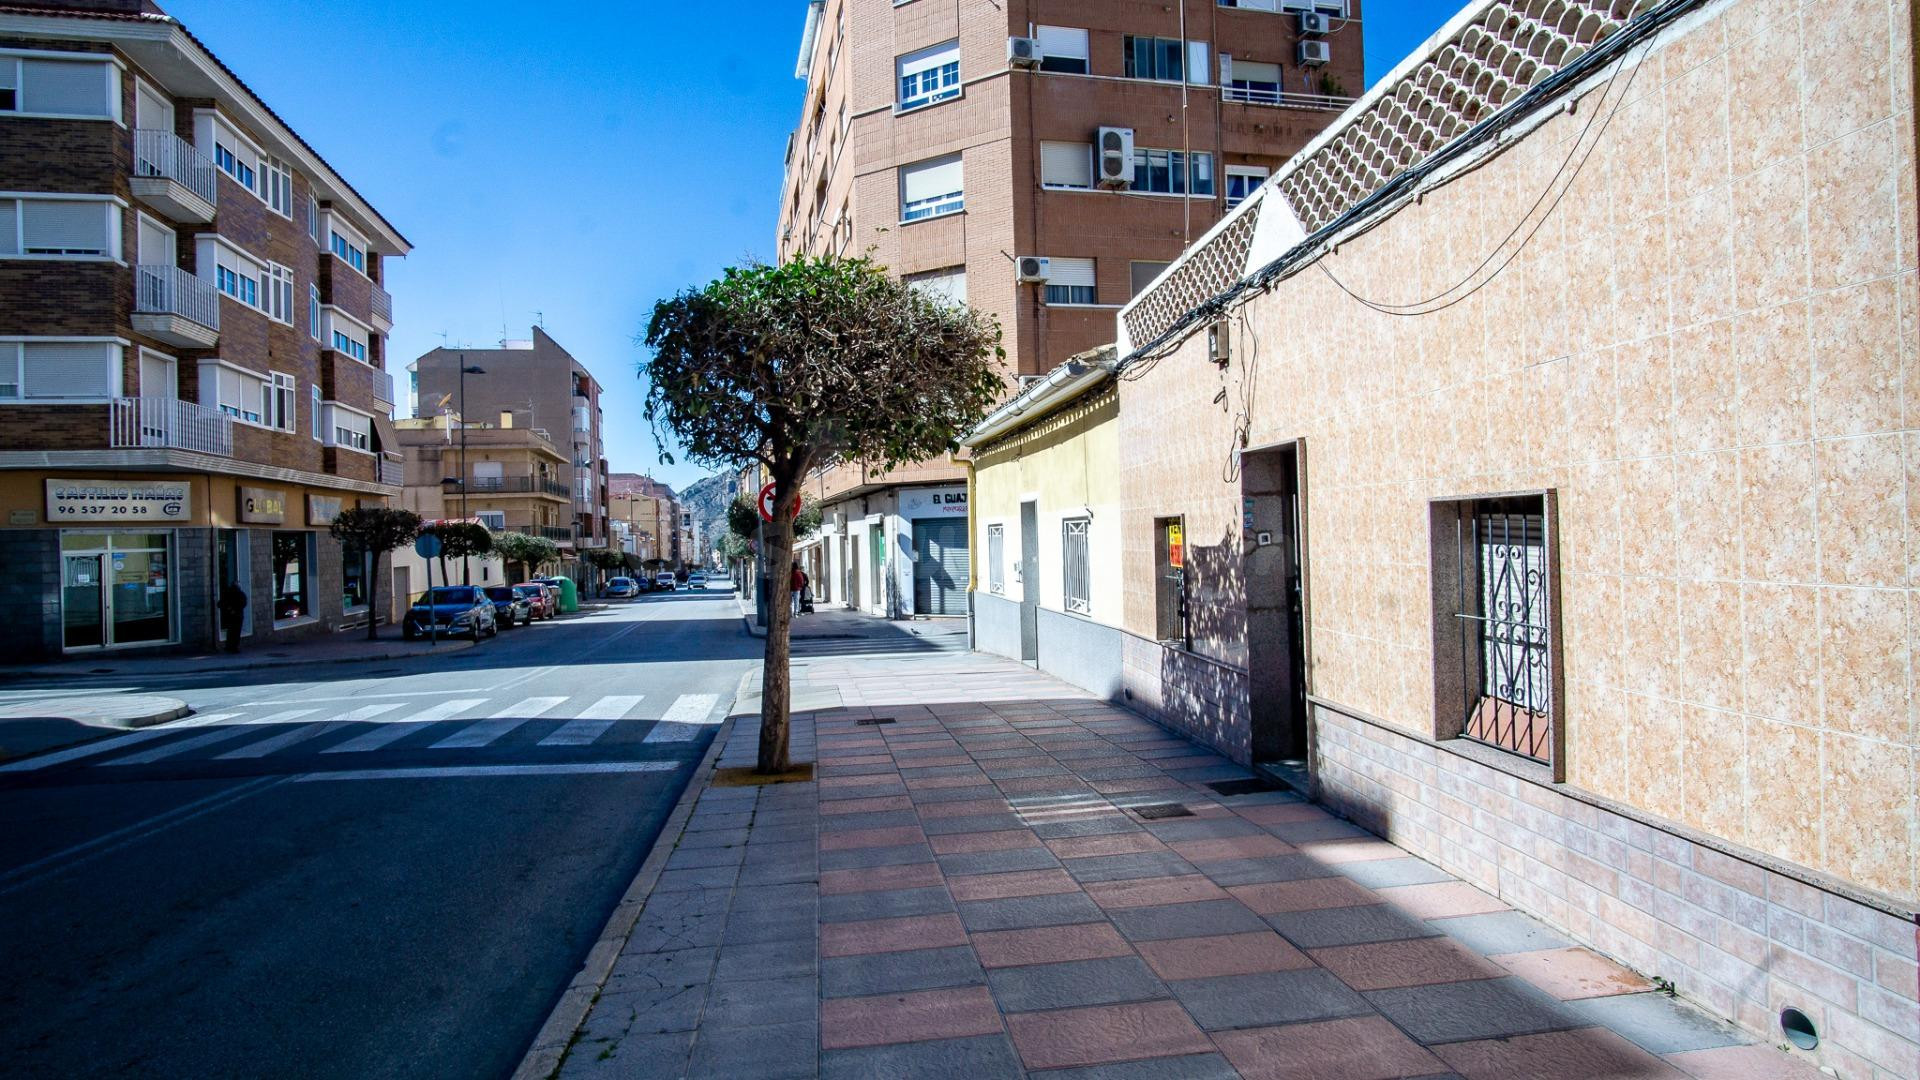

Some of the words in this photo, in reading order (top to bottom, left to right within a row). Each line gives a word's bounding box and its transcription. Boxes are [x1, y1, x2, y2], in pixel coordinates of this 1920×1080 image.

[55, 487, 128, 500] CASTILLO
[933, 494, 941, 504] EL
[58, 506, 76, 514] 96
[81, 506, 105, 514] 537
[111, 506, 127, 514] 20
[132, 506, 147, 514] 58
